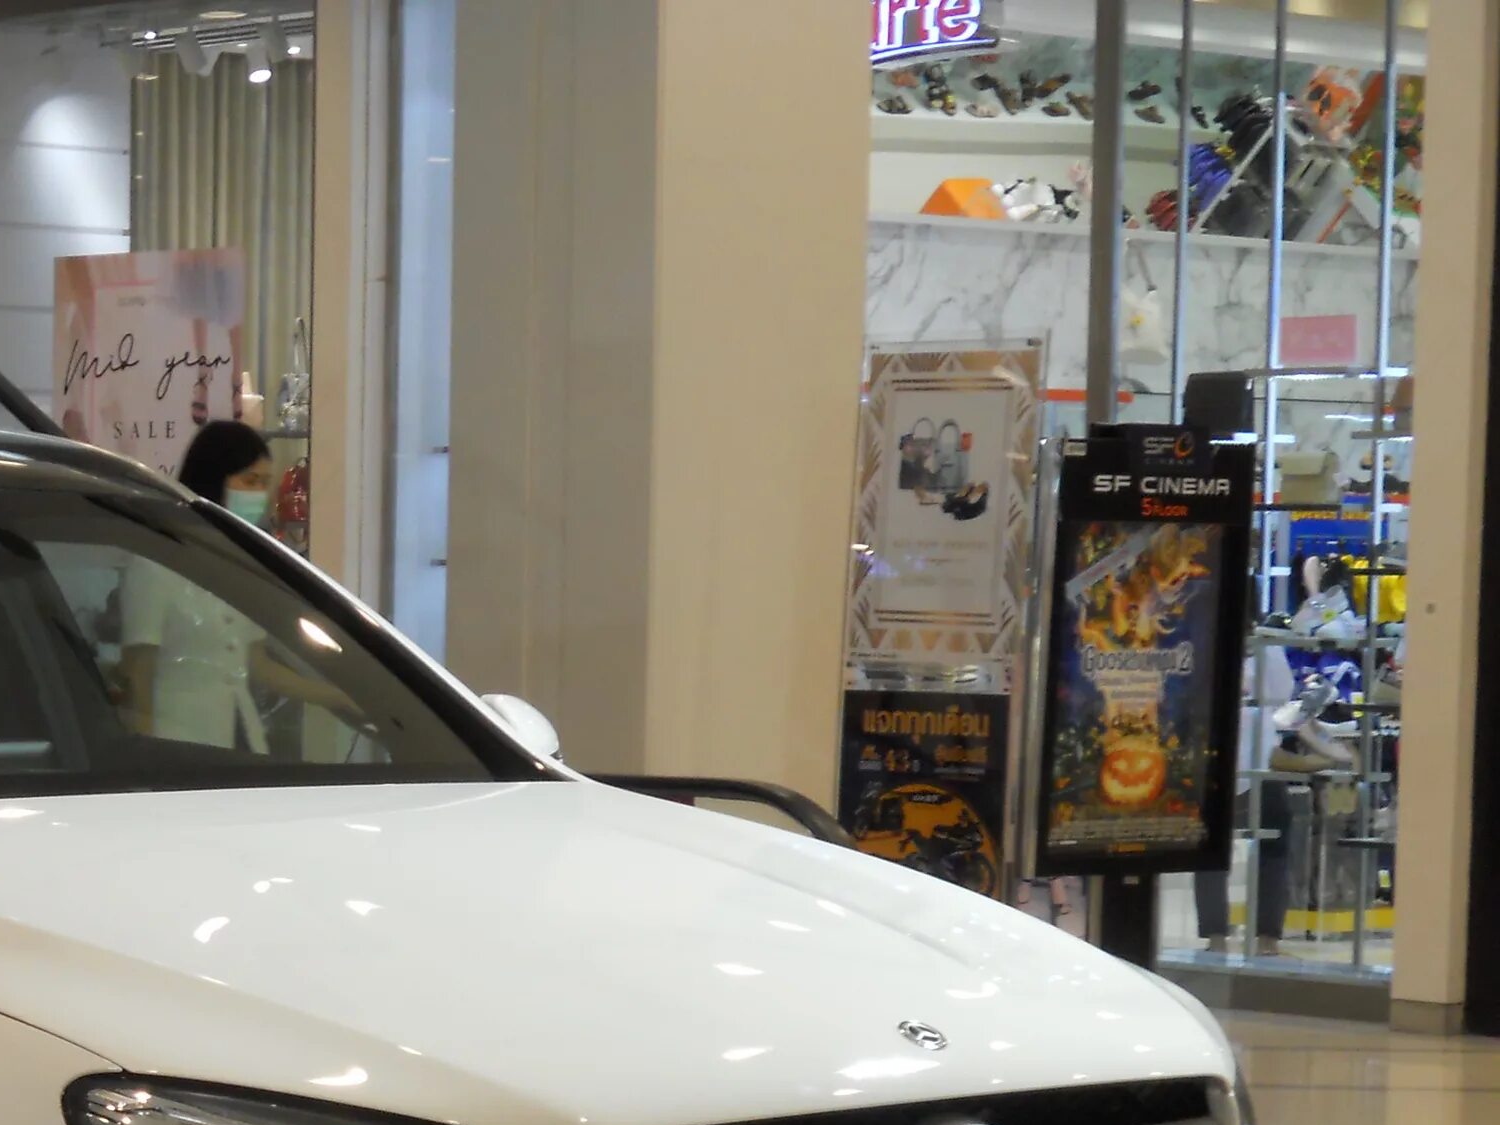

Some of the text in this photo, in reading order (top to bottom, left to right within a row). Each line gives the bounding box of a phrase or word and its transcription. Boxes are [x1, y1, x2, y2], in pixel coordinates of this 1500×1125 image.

[63, 332, 231, 400] Mid year
[112, 420, 177, 440] SALE
[1092, 474, 1232, 496] SF CINEMA
